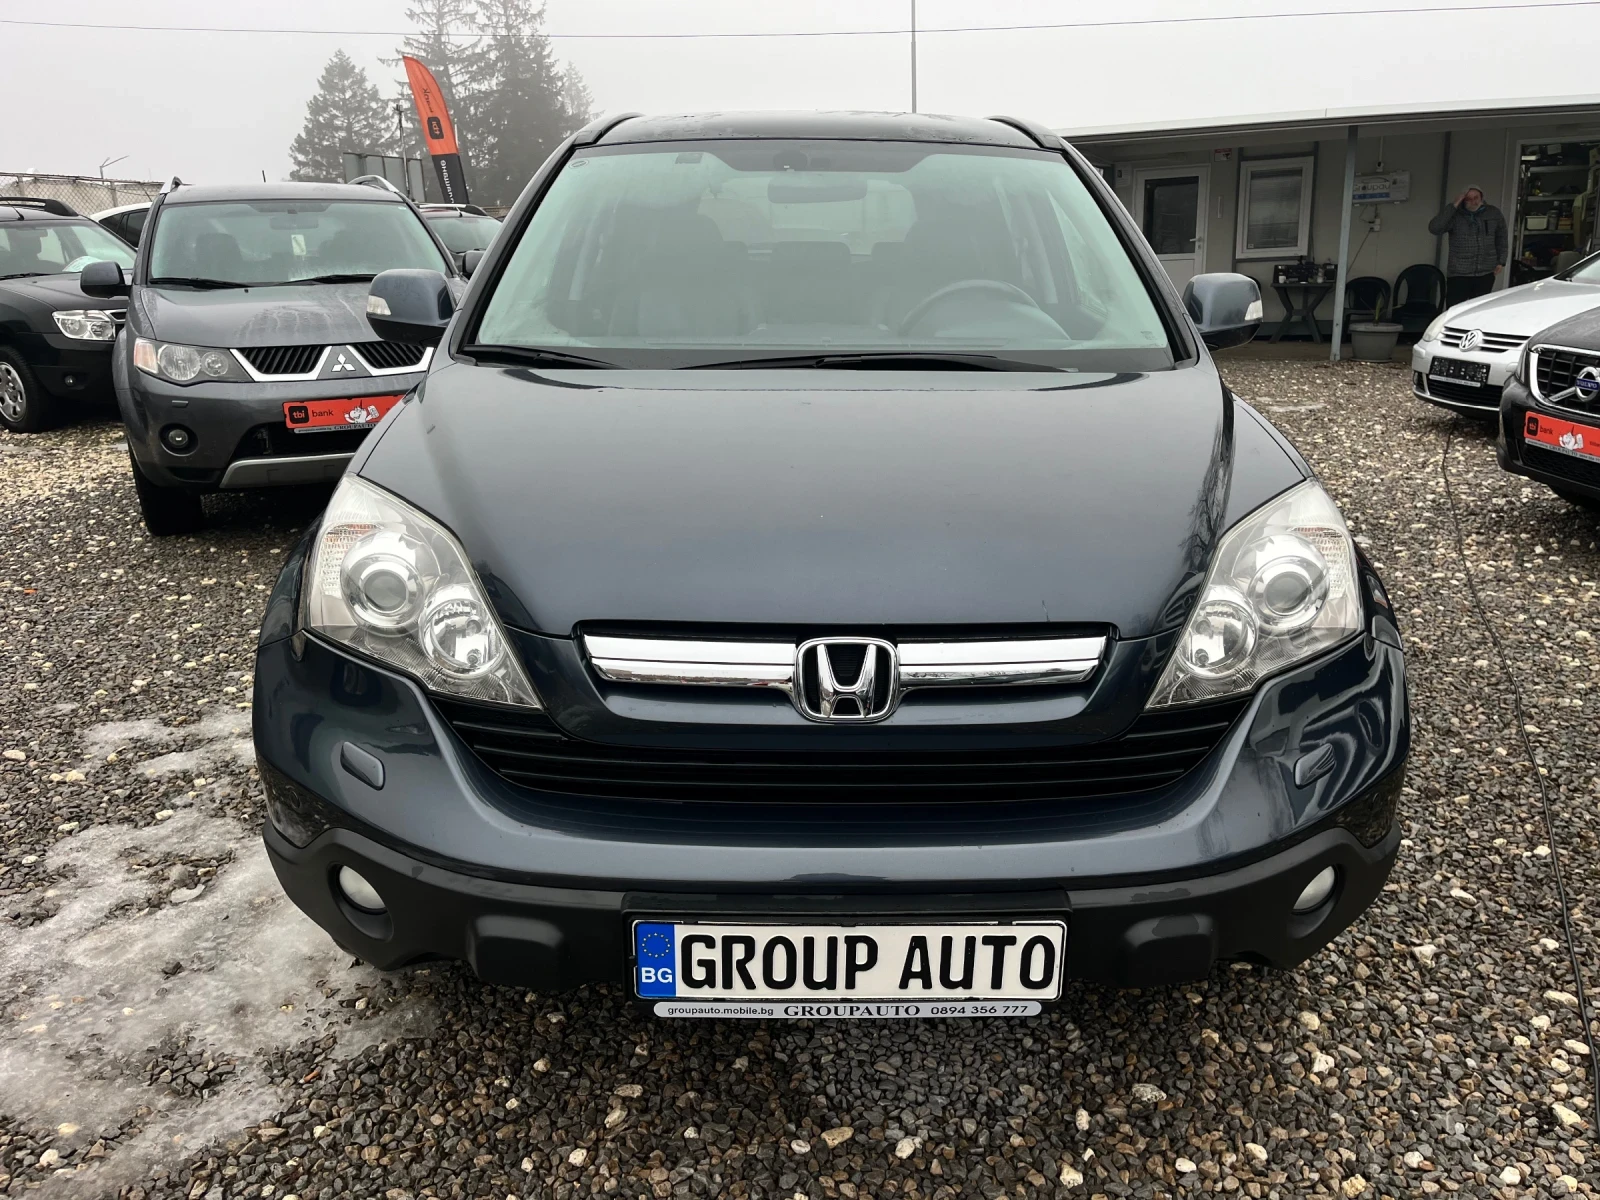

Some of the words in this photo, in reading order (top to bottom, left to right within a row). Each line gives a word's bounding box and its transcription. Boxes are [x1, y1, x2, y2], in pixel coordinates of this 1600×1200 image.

[1576, 380, 1598, 389] VOLVO
[293, 410, 306, 419] tbi
[312, 409, 334, 418] bank
[1540, 425, 1553, 435] bank
[681, 934, 879, 990] GROUP
[899, 935, 1056, 990] AUTO
[641, 967, 673, 983] BG
[667, 1006, 774, 1016] groupauto.mobile.bg
[783, 1005, 921, 1017] GROUPAUTO
[930, 1006, 966, 1015] 0894
[971, 1005, 997, 1014] 356
[1002, 1005, 1029, 1014] 777
